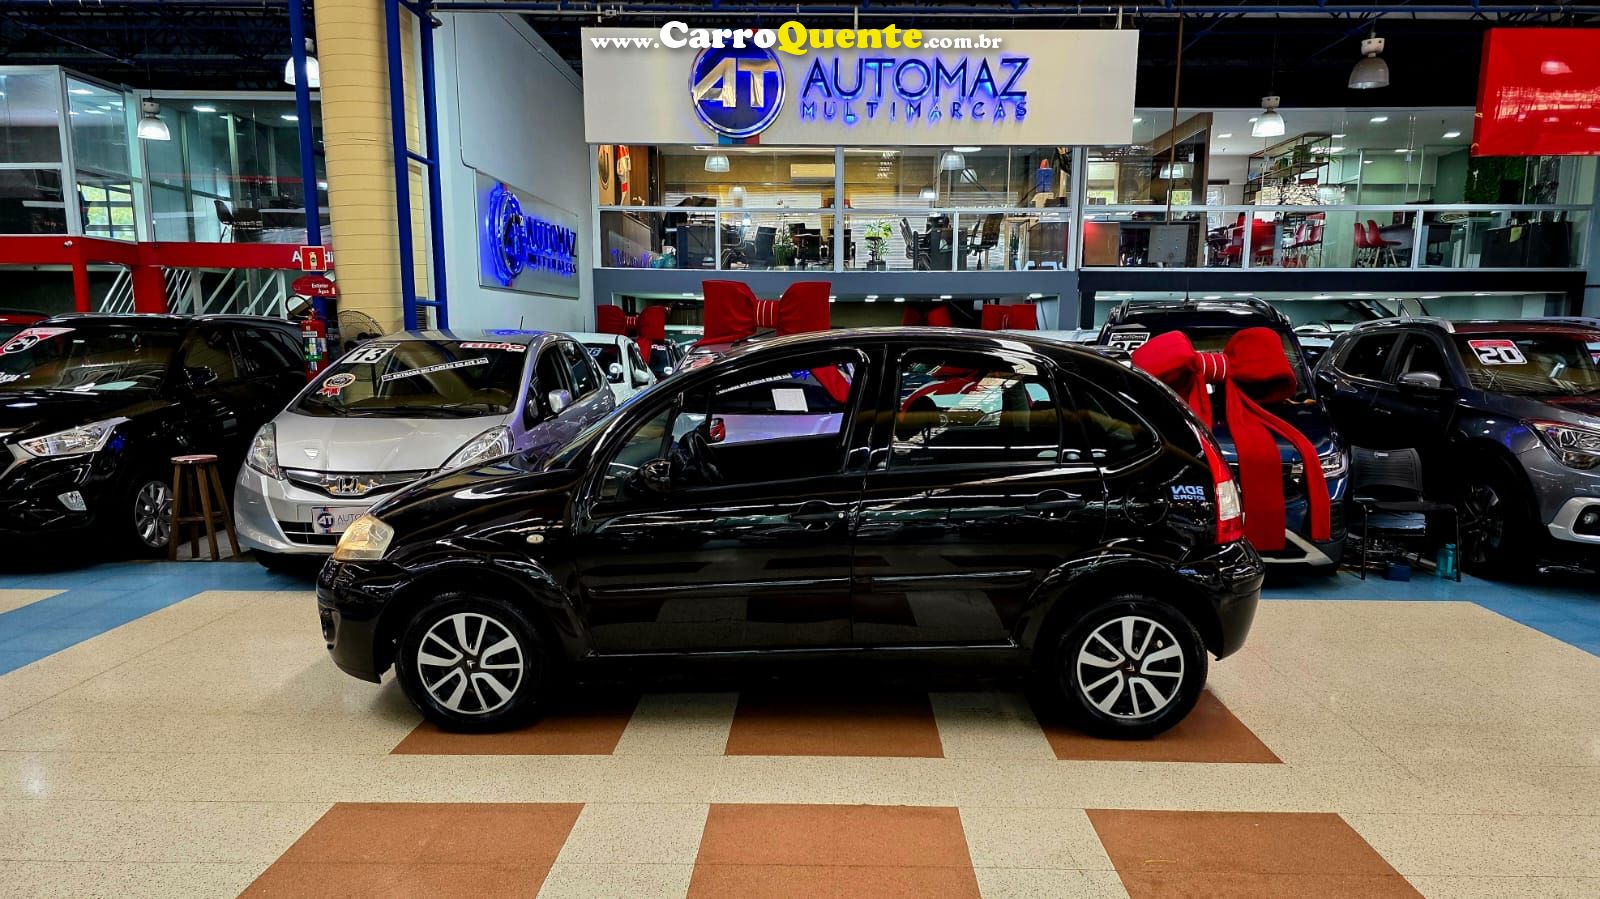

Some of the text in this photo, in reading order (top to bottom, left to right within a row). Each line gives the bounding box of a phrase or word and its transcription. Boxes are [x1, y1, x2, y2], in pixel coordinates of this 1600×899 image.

[691, 57, 778, 108] AT
[802, 57, 1029, 98] AUTOMAZ
[802, 101, 1027, 119] MULTIMARCAS
[353, 348, 388, 361] 13
[1478, 347, 1525, 363] 20
